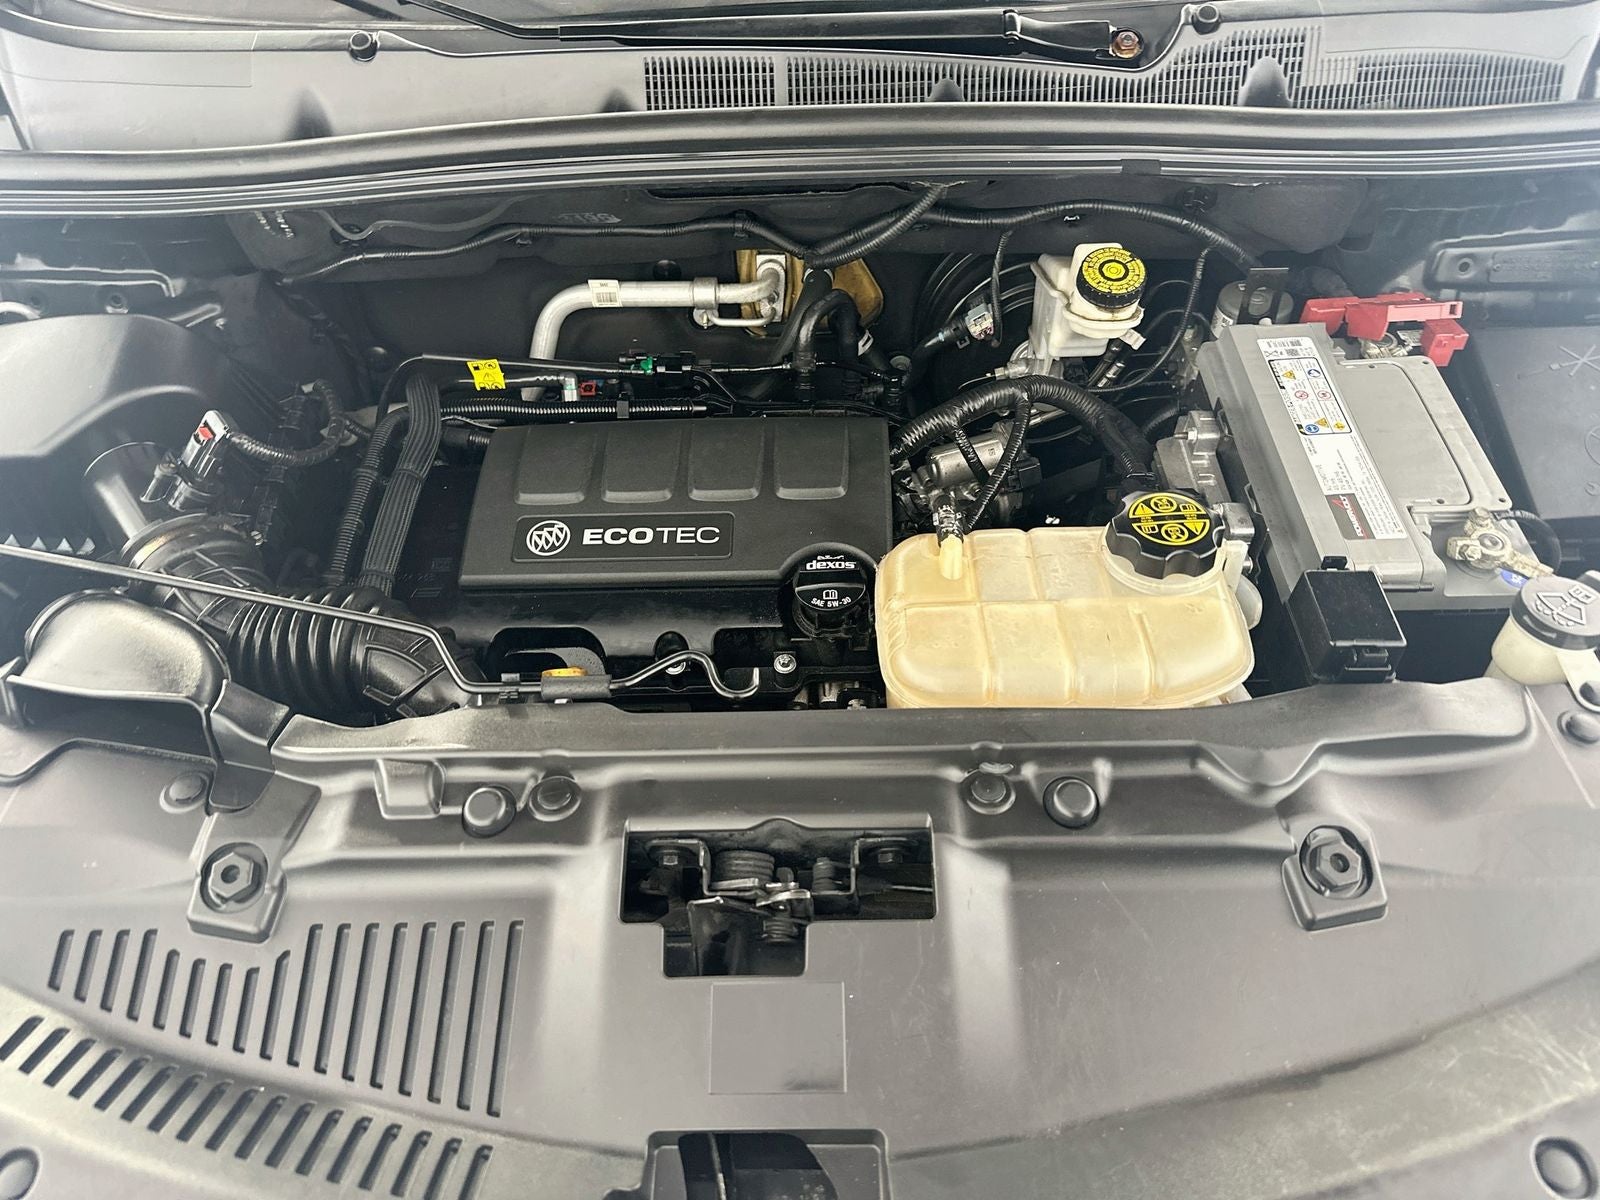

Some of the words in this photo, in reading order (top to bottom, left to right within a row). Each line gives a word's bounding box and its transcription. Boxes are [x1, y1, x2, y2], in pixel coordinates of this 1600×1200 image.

[582, 526, 720, 545] ECOTEC
[805, 560, 857, 570] dexos
[811, 597, 825, 607] SAE
[827, 596, 852, 607] 5W-30
